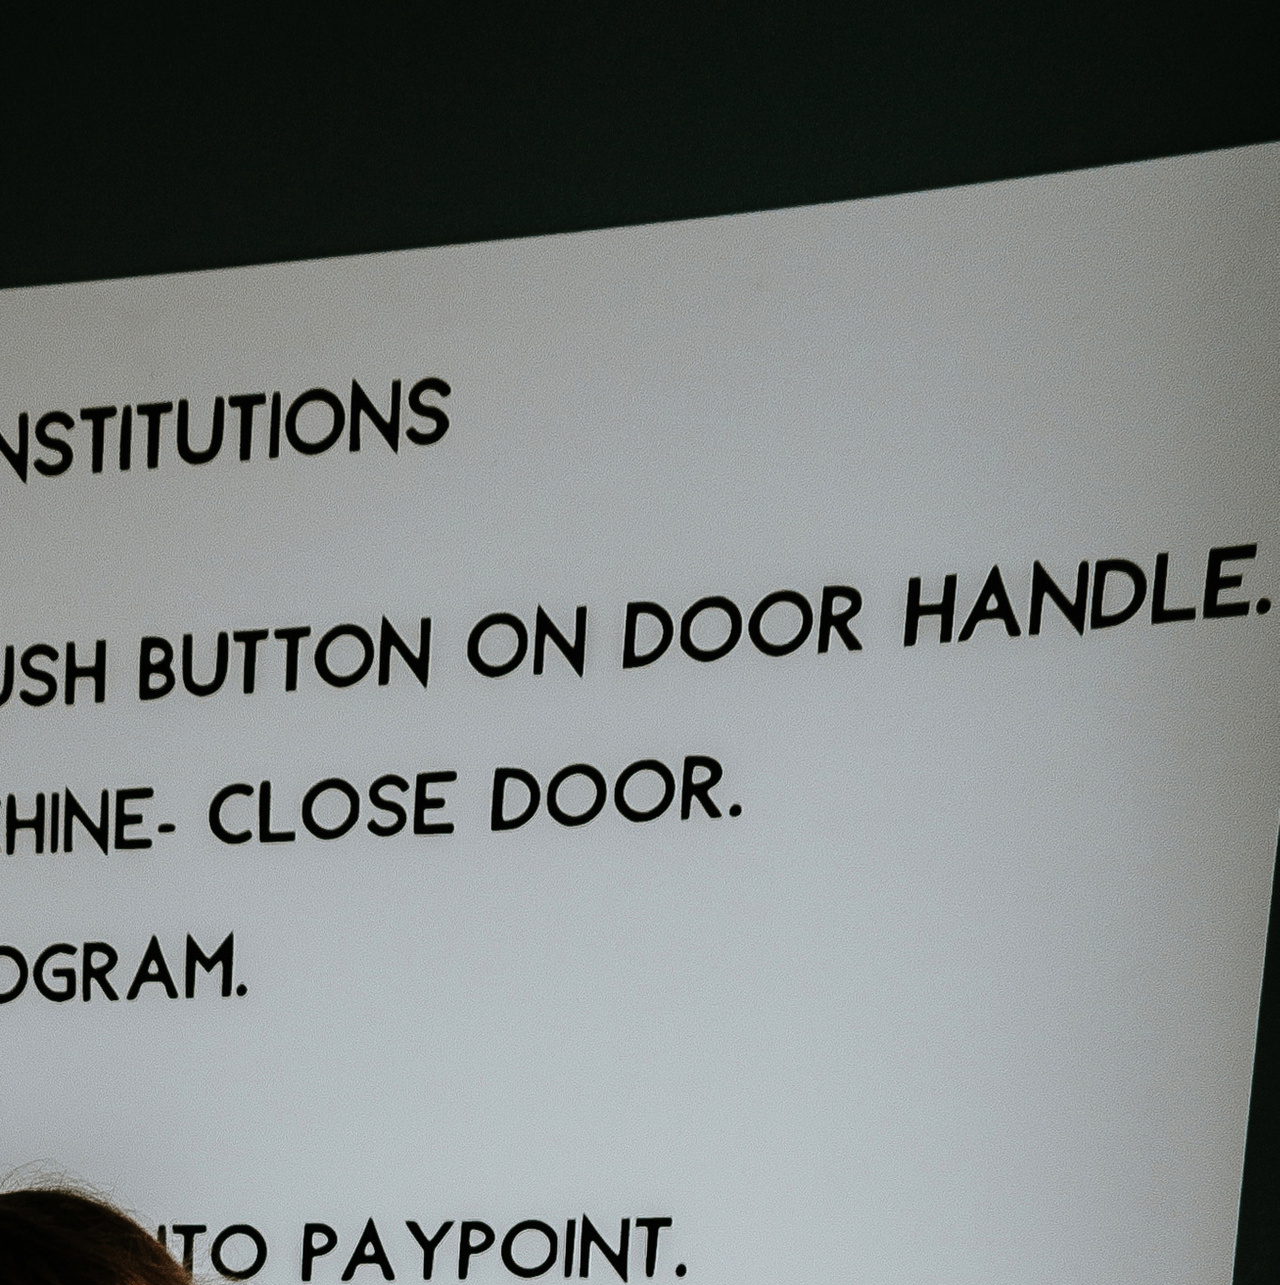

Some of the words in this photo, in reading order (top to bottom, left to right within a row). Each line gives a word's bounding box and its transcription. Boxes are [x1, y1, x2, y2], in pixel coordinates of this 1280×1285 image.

[137, 614, 433, 702] BUTTON
[466, 603, 589, 680] ON
[621, 584, 864, 670] DOOR
[902, 541, 1273, 649] HANDLE.
[207, 769, 459, 846] CLOSE
[489, 754, 743, 833] DOOR.
[300, 1213, 688, 1284] PAYPOINT.
